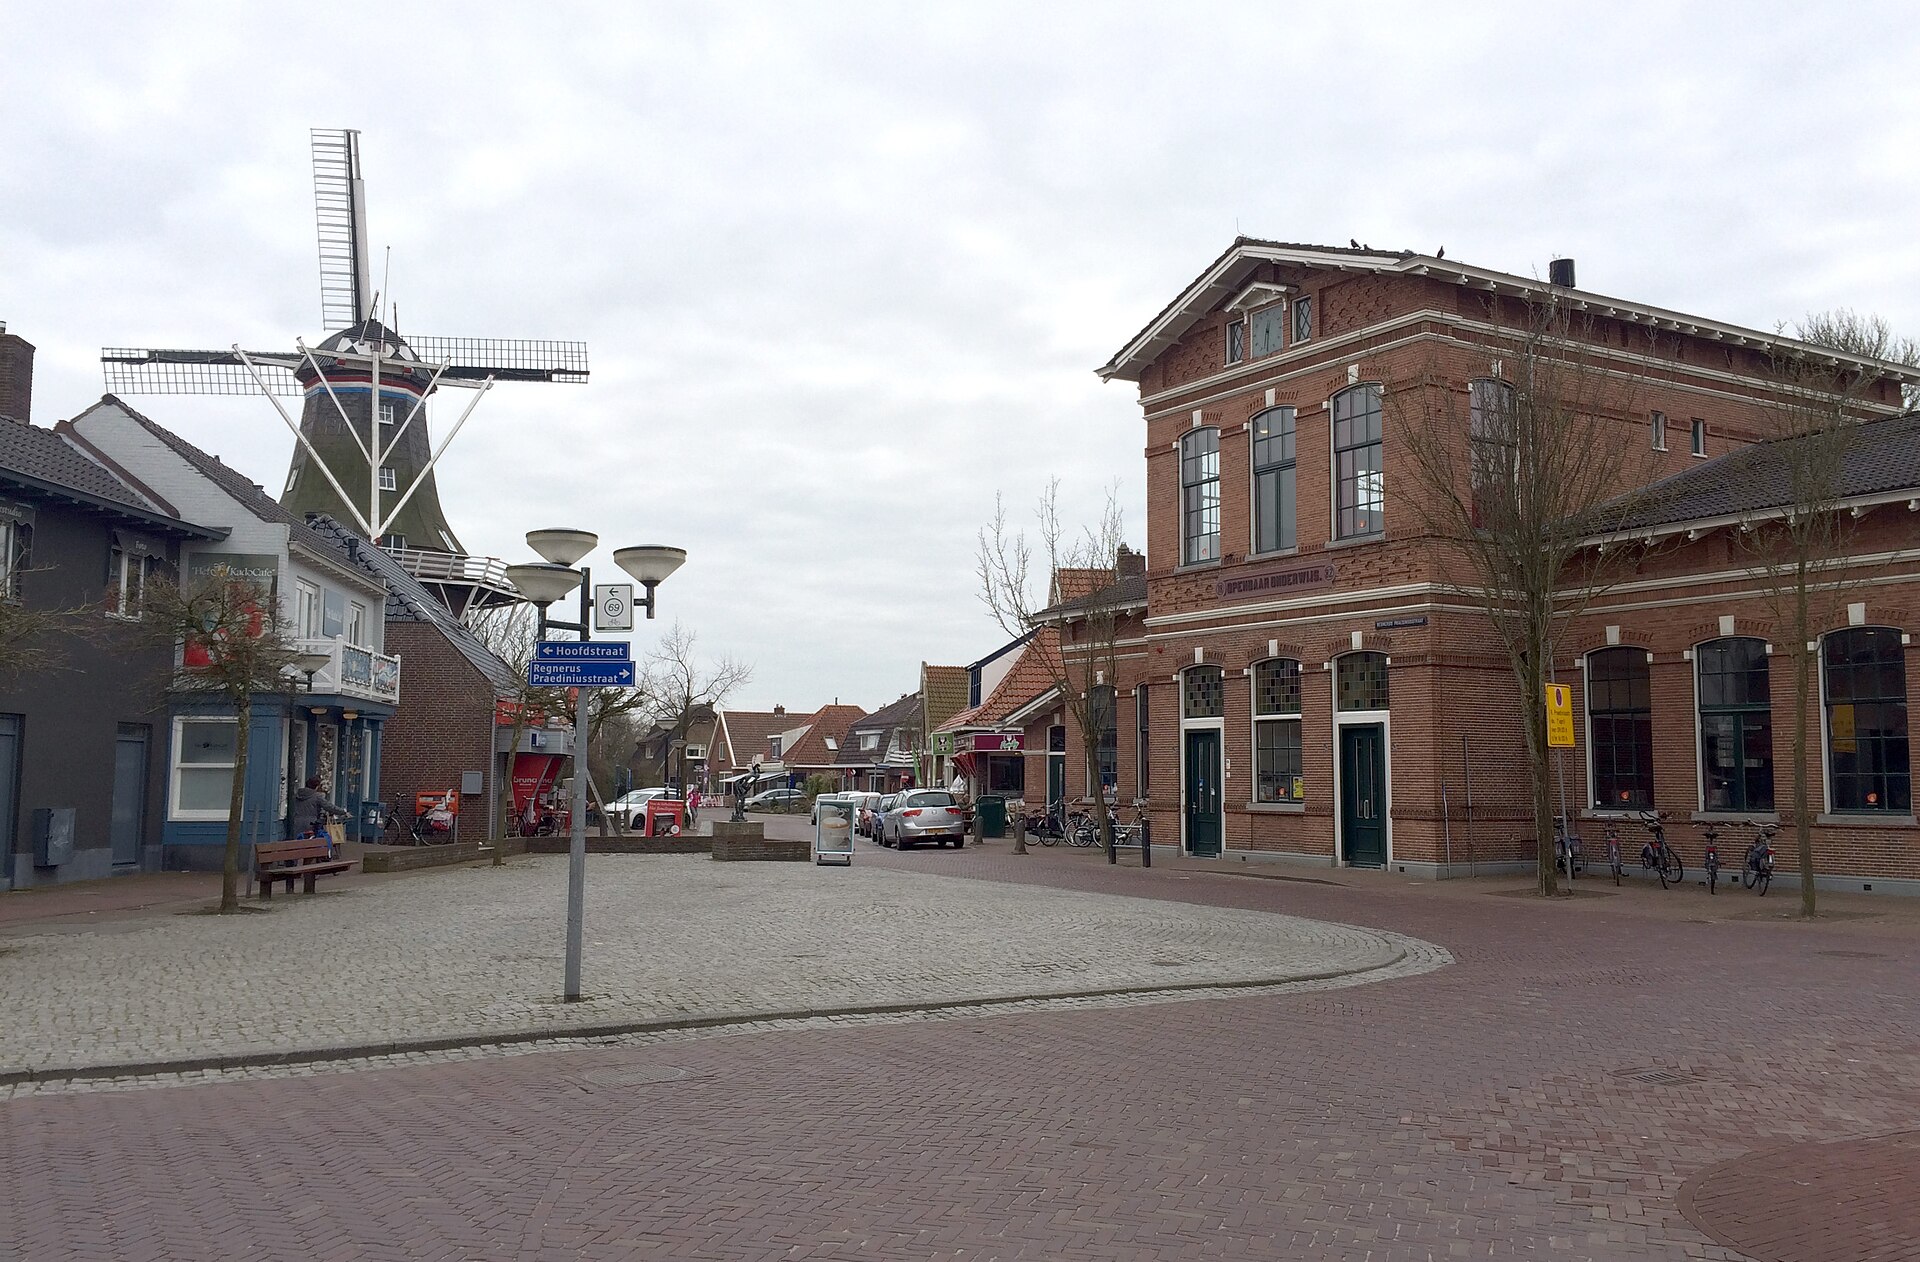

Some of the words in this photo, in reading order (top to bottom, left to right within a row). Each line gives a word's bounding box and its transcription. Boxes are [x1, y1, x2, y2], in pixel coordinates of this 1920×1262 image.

[1227, 577, 1270, 594] OPENBAAR
[608, 603, 620, 612] 69
[556, 646, 624, 656] Hoofdstraat
[533, 664, 581, 675] Regnerus
[533, 674, 618, 683] Praediniusstraat
[513, 776, 538, 784] bruna
